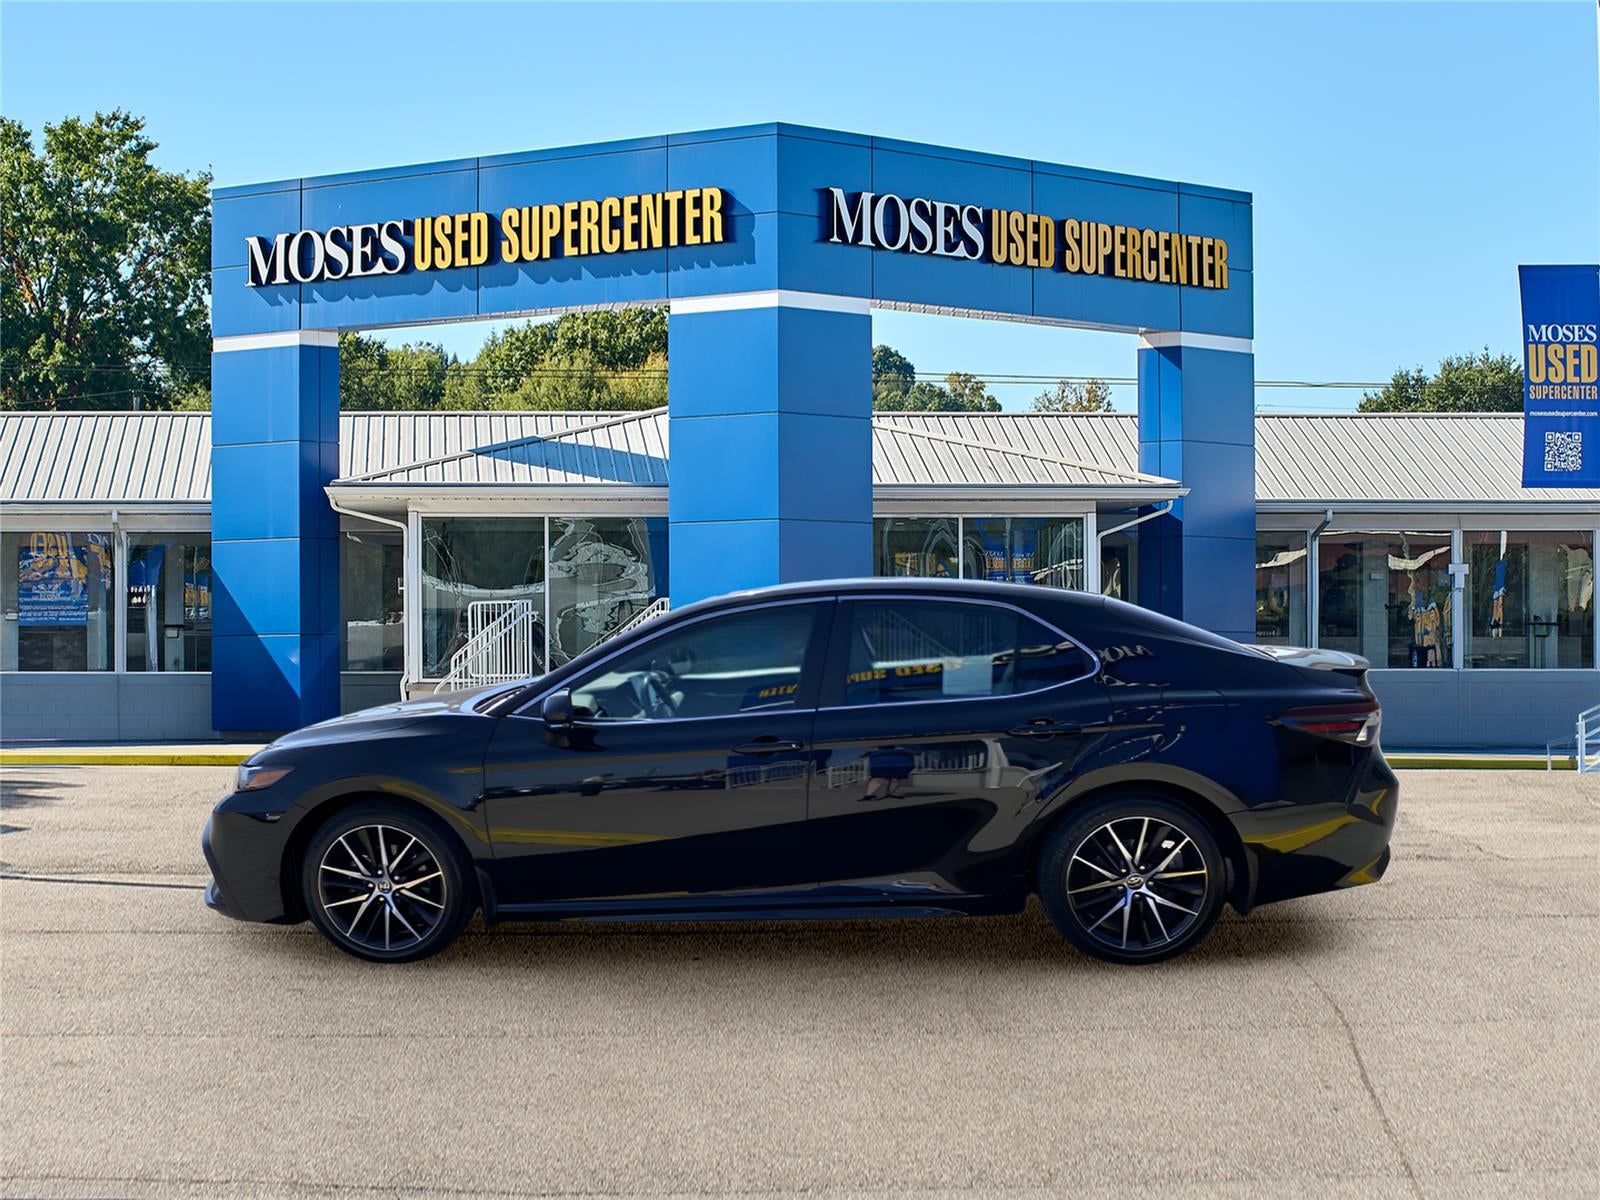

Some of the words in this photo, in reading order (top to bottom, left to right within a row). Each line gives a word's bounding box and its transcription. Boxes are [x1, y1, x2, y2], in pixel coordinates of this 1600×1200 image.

[244, 220, 407, 287] MOSES
[414, 211, 489, 272] USED
[500, 187, 725, 264] SUPERCENTER
[828, 187, 985, 260] MOSES
[991, 208, 1056, 269] USED
[1065, 218, 1230, 289] SUPERCENTER
[1527, 323, 1597, 343] MOSES
[1528, 343, 1598, 384] USED
[1529, 385, 1598, 400] SUPERCENTER
[1529, 410, 1598, 418] mosesusedsupercenter.com
